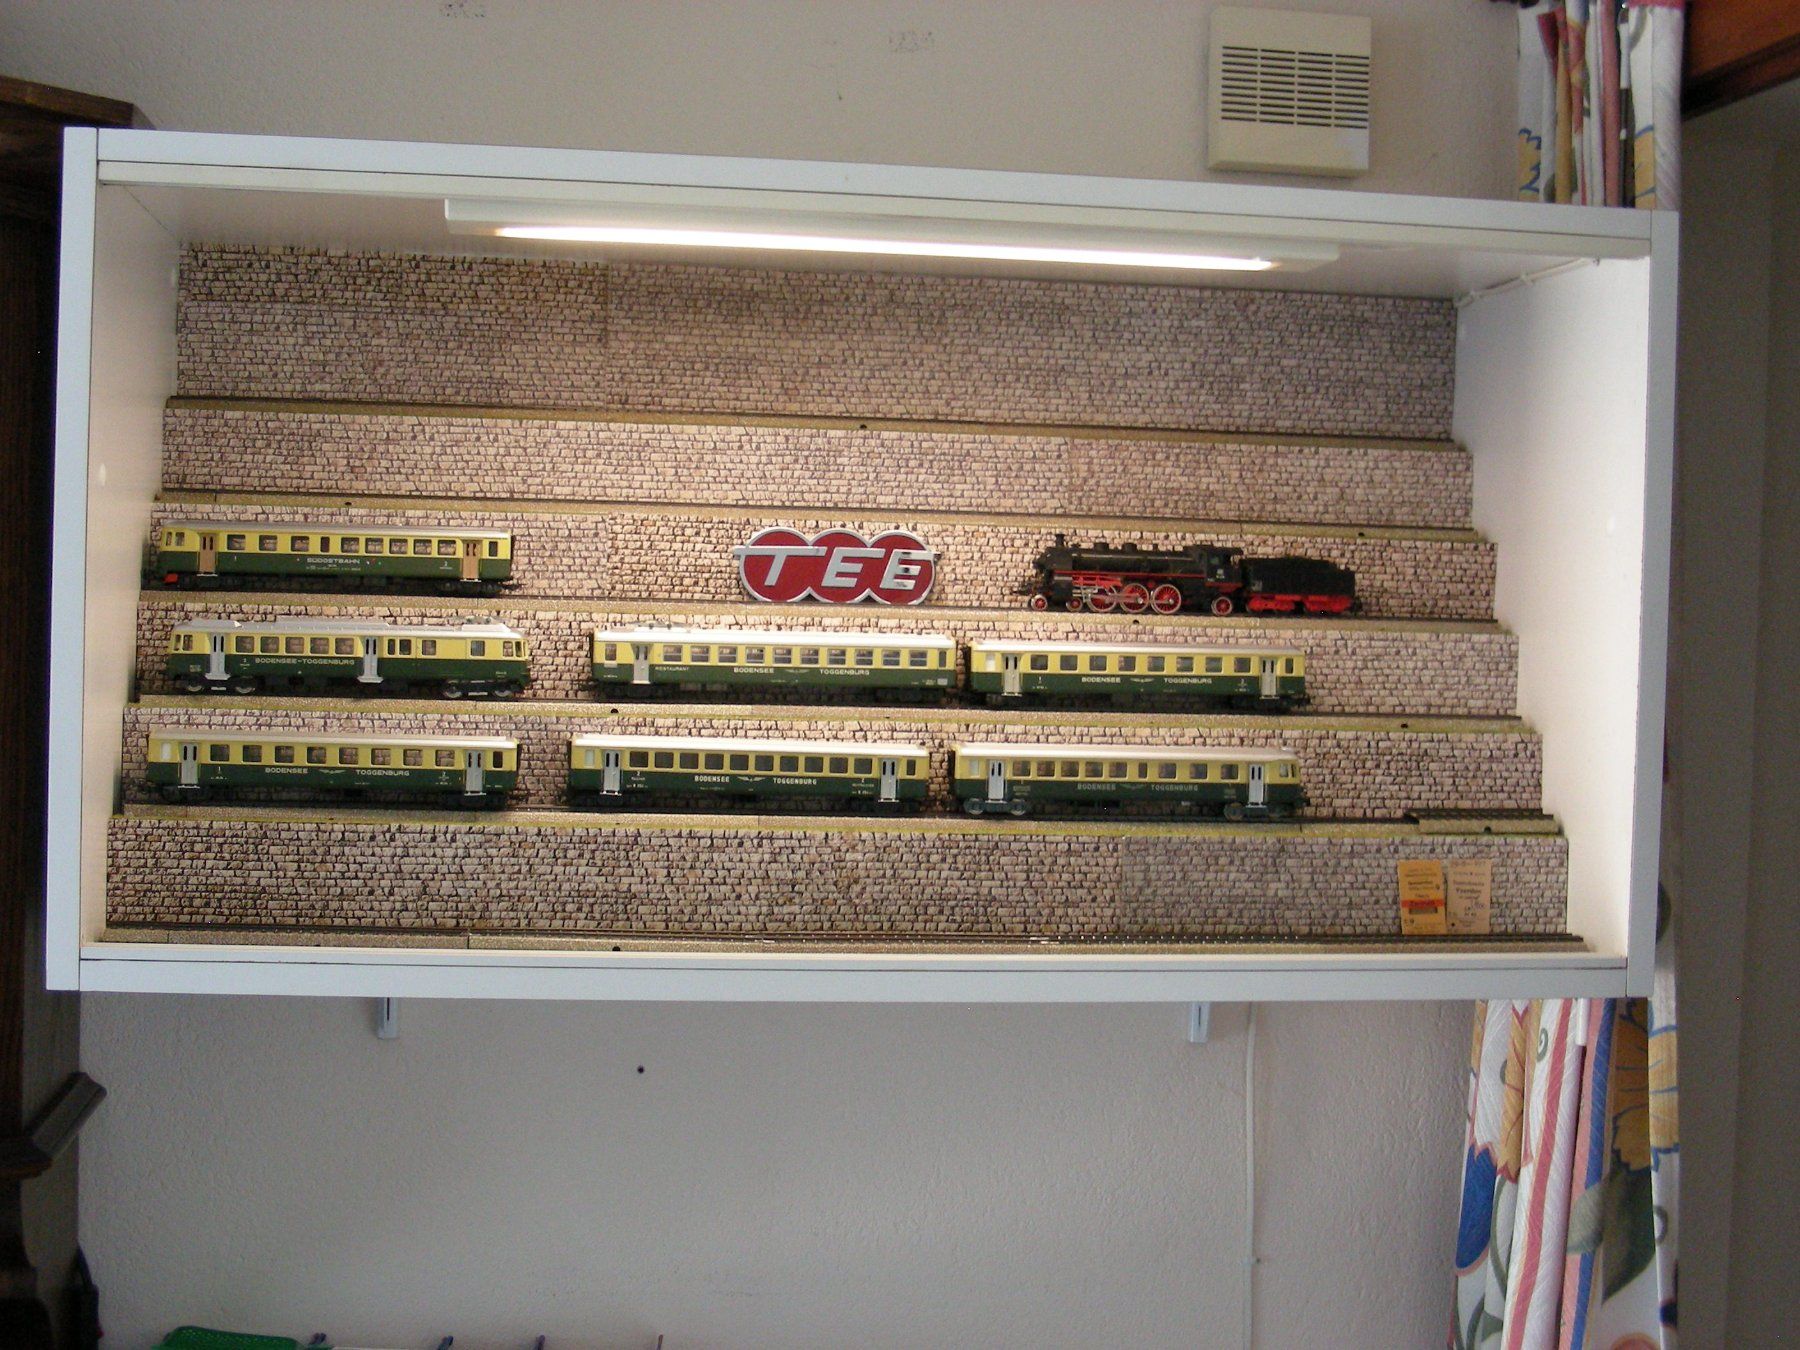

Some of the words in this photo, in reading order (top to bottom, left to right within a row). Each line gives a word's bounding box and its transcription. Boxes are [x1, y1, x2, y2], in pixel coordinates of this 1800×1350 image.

[733, 546, 934, 590] TEE
[773, 777, 817, 785] TOGGENBURG
[1151, 784, 1199, 792] TOGGENBURG
